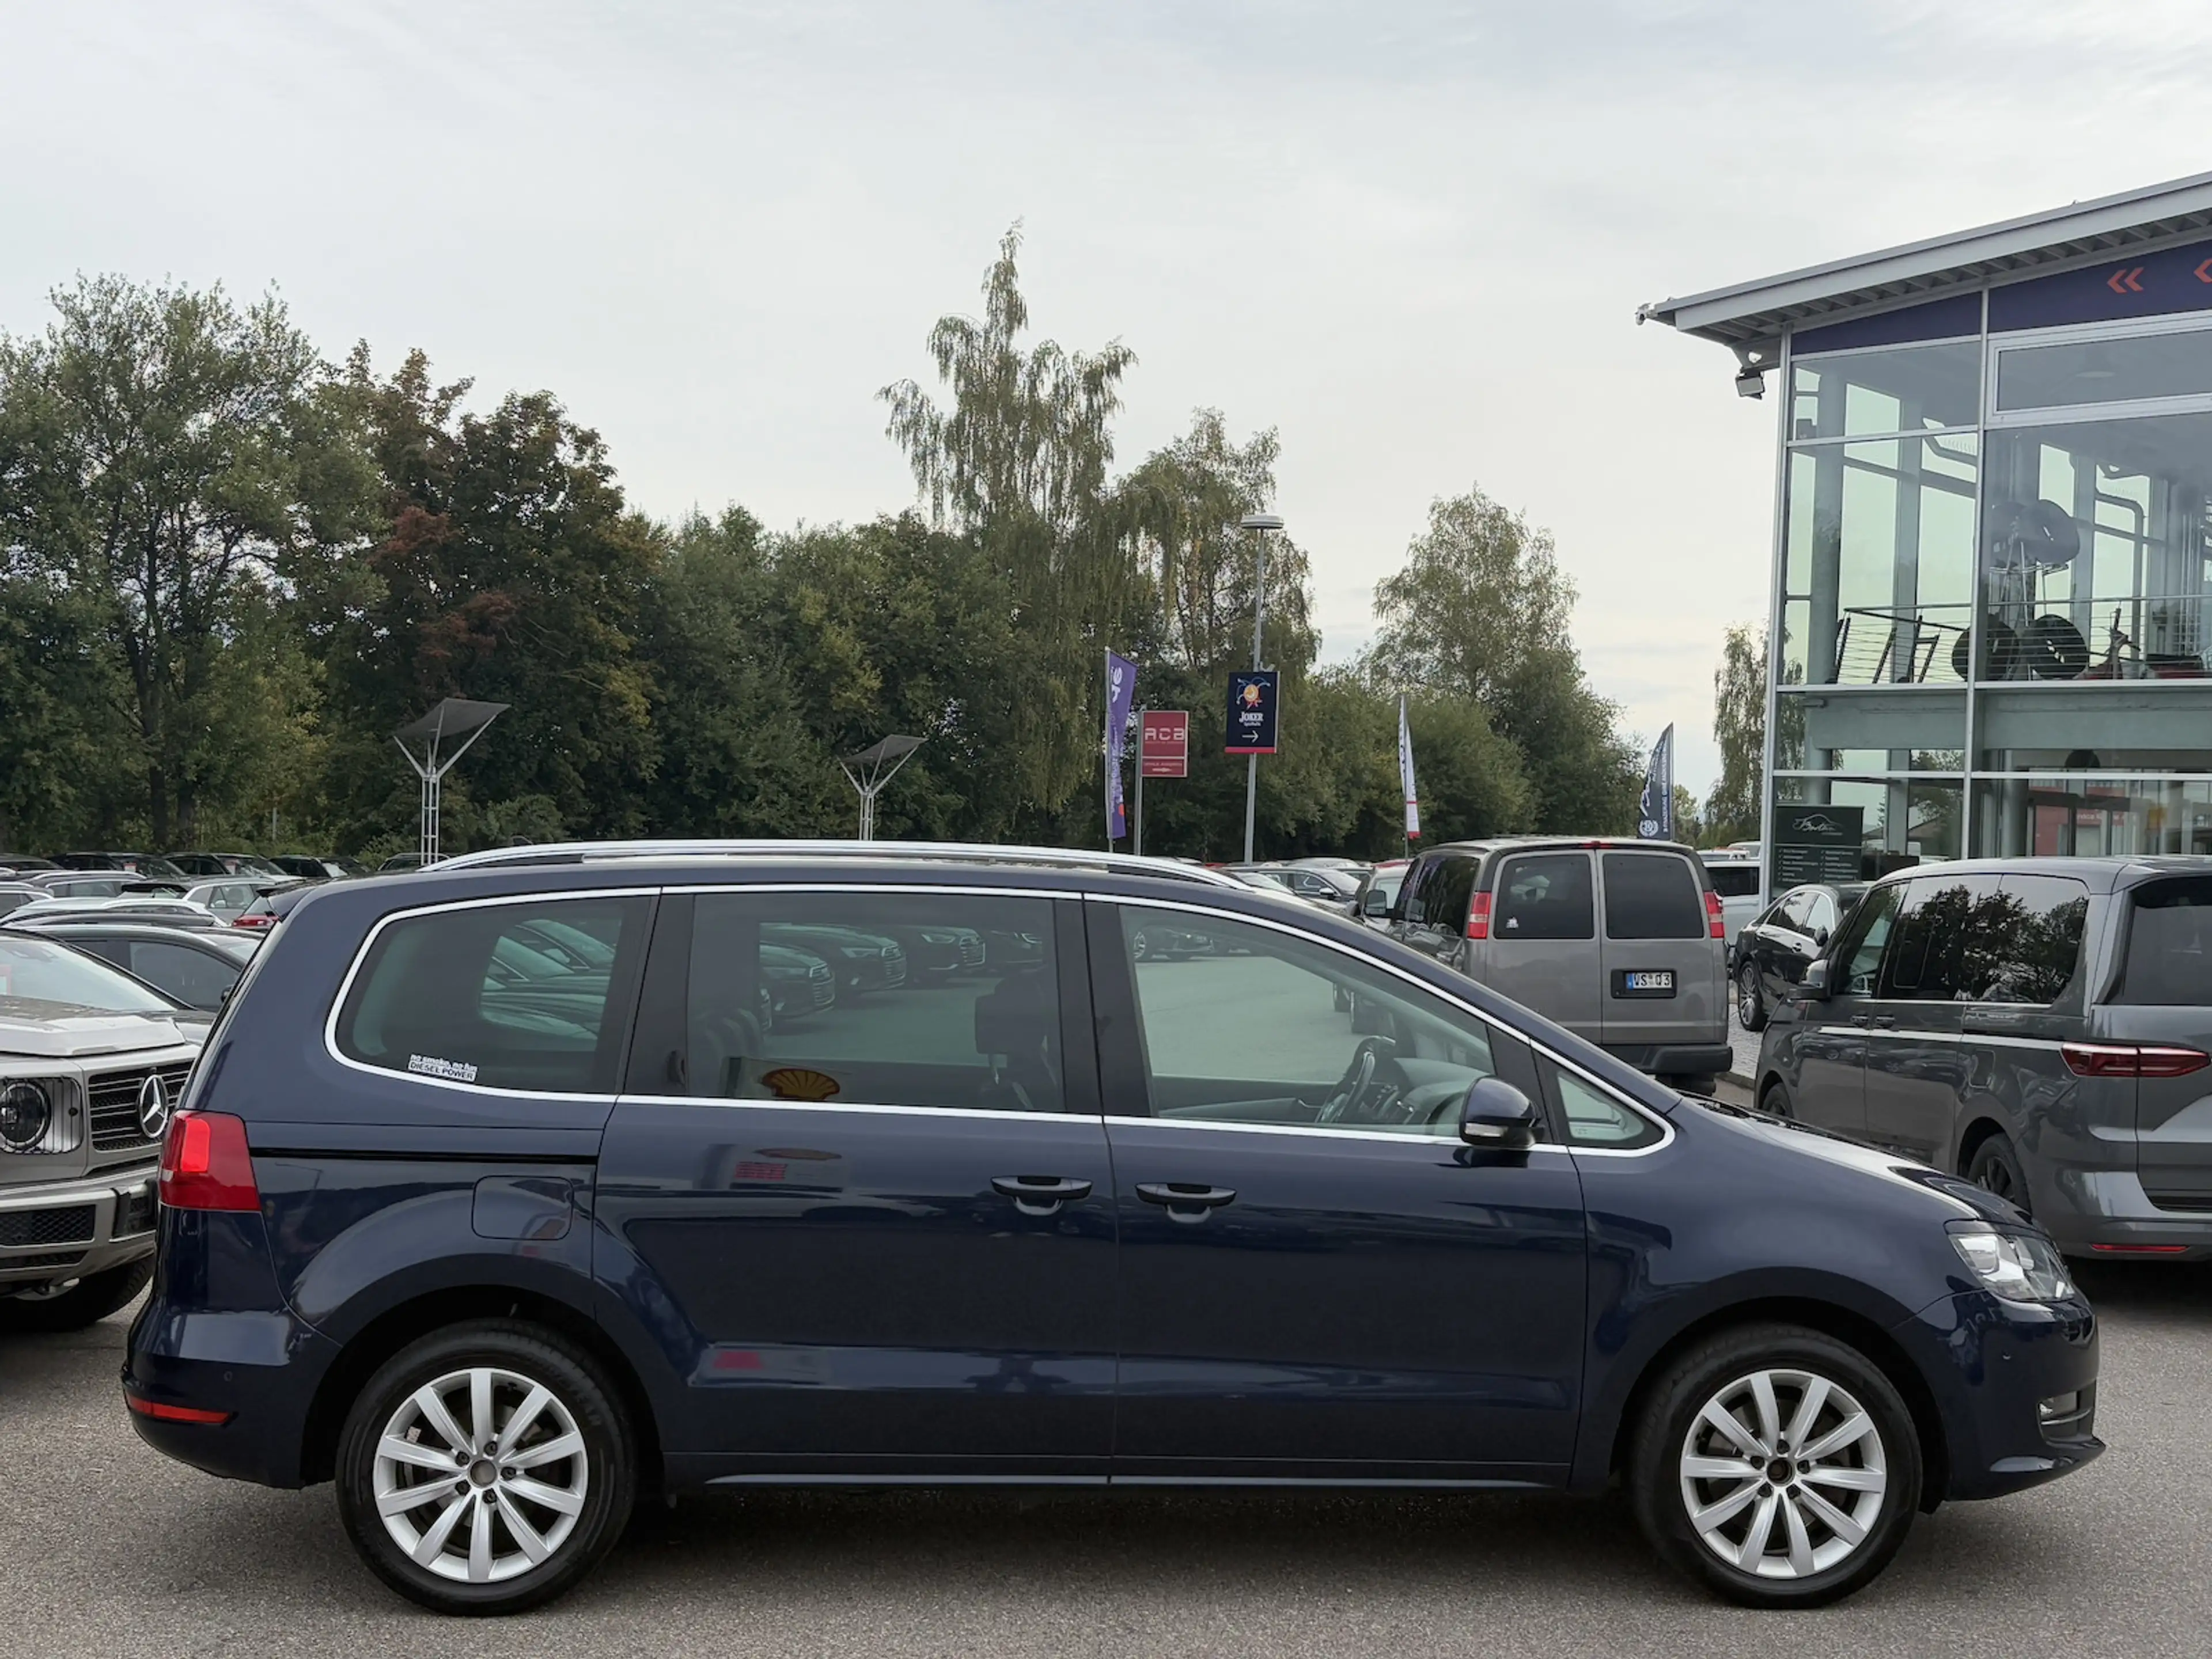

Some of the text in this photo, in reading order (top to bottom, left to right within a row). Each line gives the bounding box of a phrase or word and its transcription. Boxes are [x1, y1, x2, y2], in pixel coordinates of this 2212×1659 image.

[1239, 712, 1263, 722] JOKER
[1634, 973, 1647, 986] VS
[410, 1061, 474, 1080] DIESEL POWER
